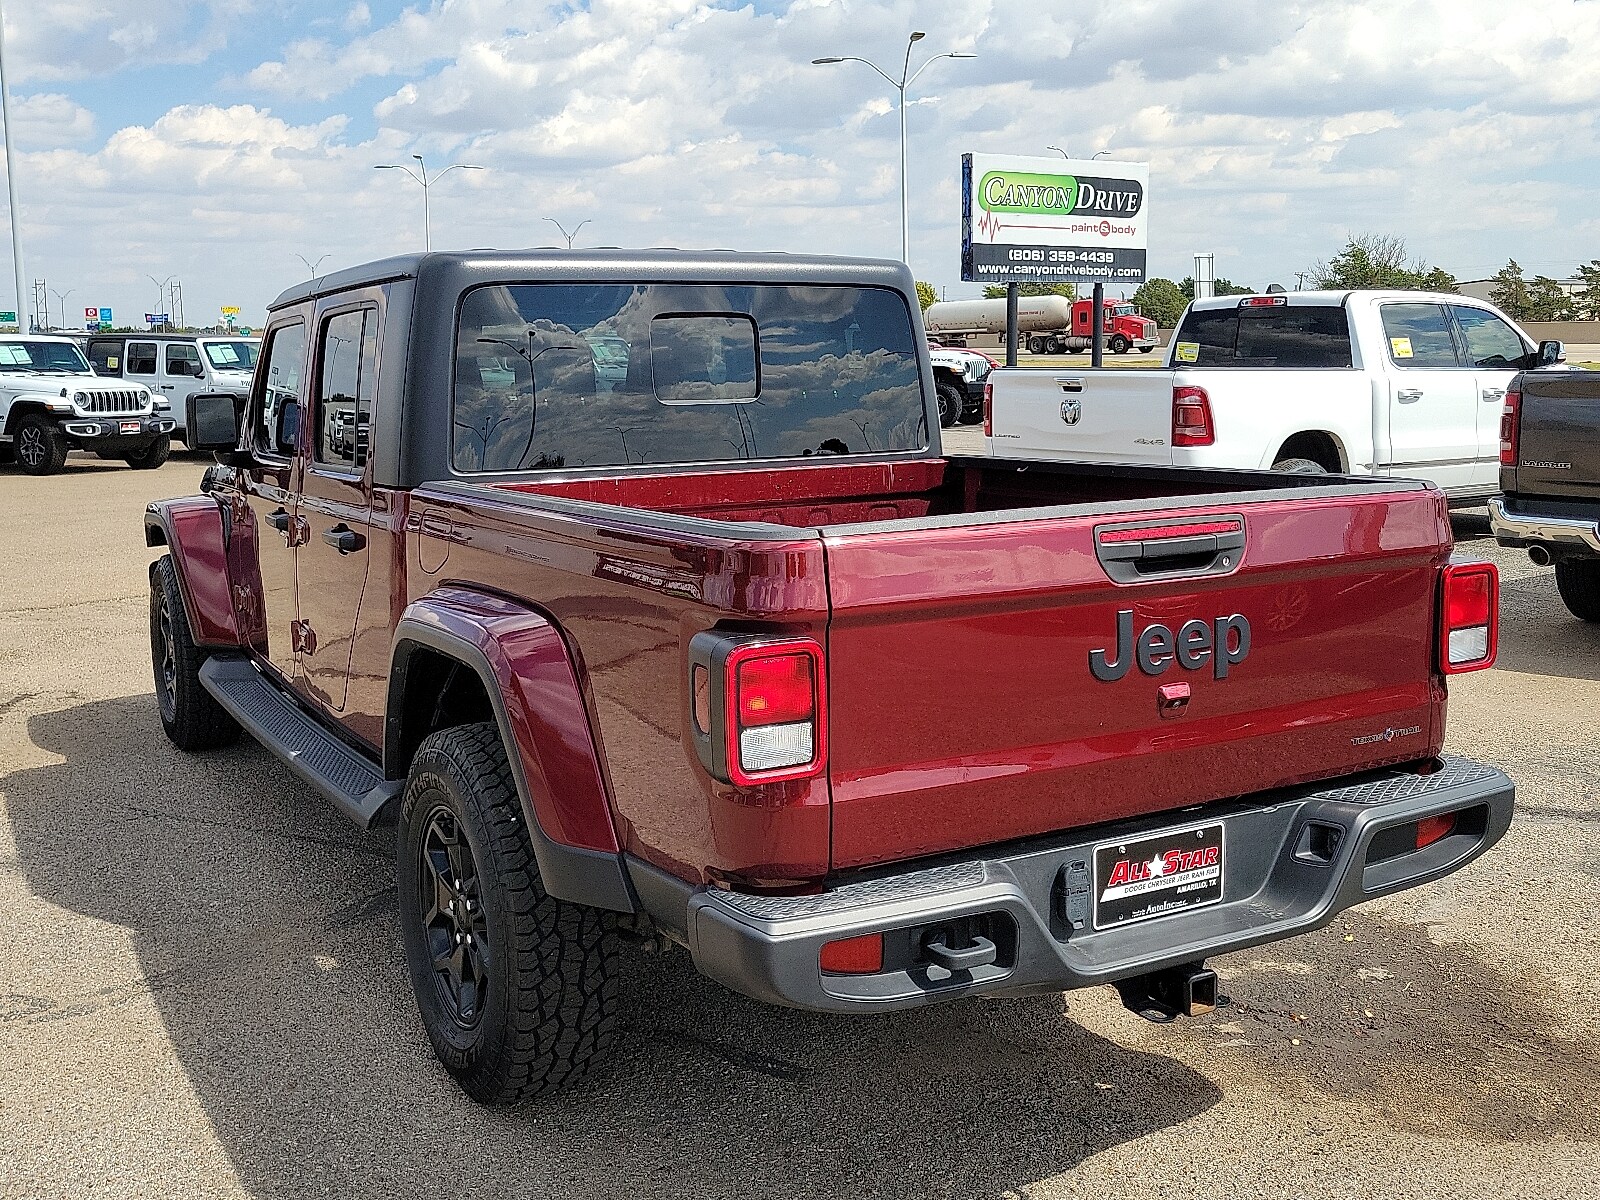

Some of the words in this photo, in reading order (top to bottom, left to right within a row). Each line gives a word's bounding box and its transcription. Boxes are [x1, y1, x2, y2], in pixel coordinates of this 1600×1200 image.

[1071, 223, 1099, 234] paint
[1111, 225, 1137, 236] body
[1008, 249, 1045, 262] (806)
[1049, 250, 1114, 263] 359-4439
[977, 263, 1142, 278] www.canyondrivebody.com
[1088, 609, 1252, 682] Jeep
[1162, 846, 1219, 876] STAR
[1124, 883, 1147, 894] DODGE
[1147, 875, 1176, 889] CHRYSLER
[1209, 878, 1217, 887] TX
